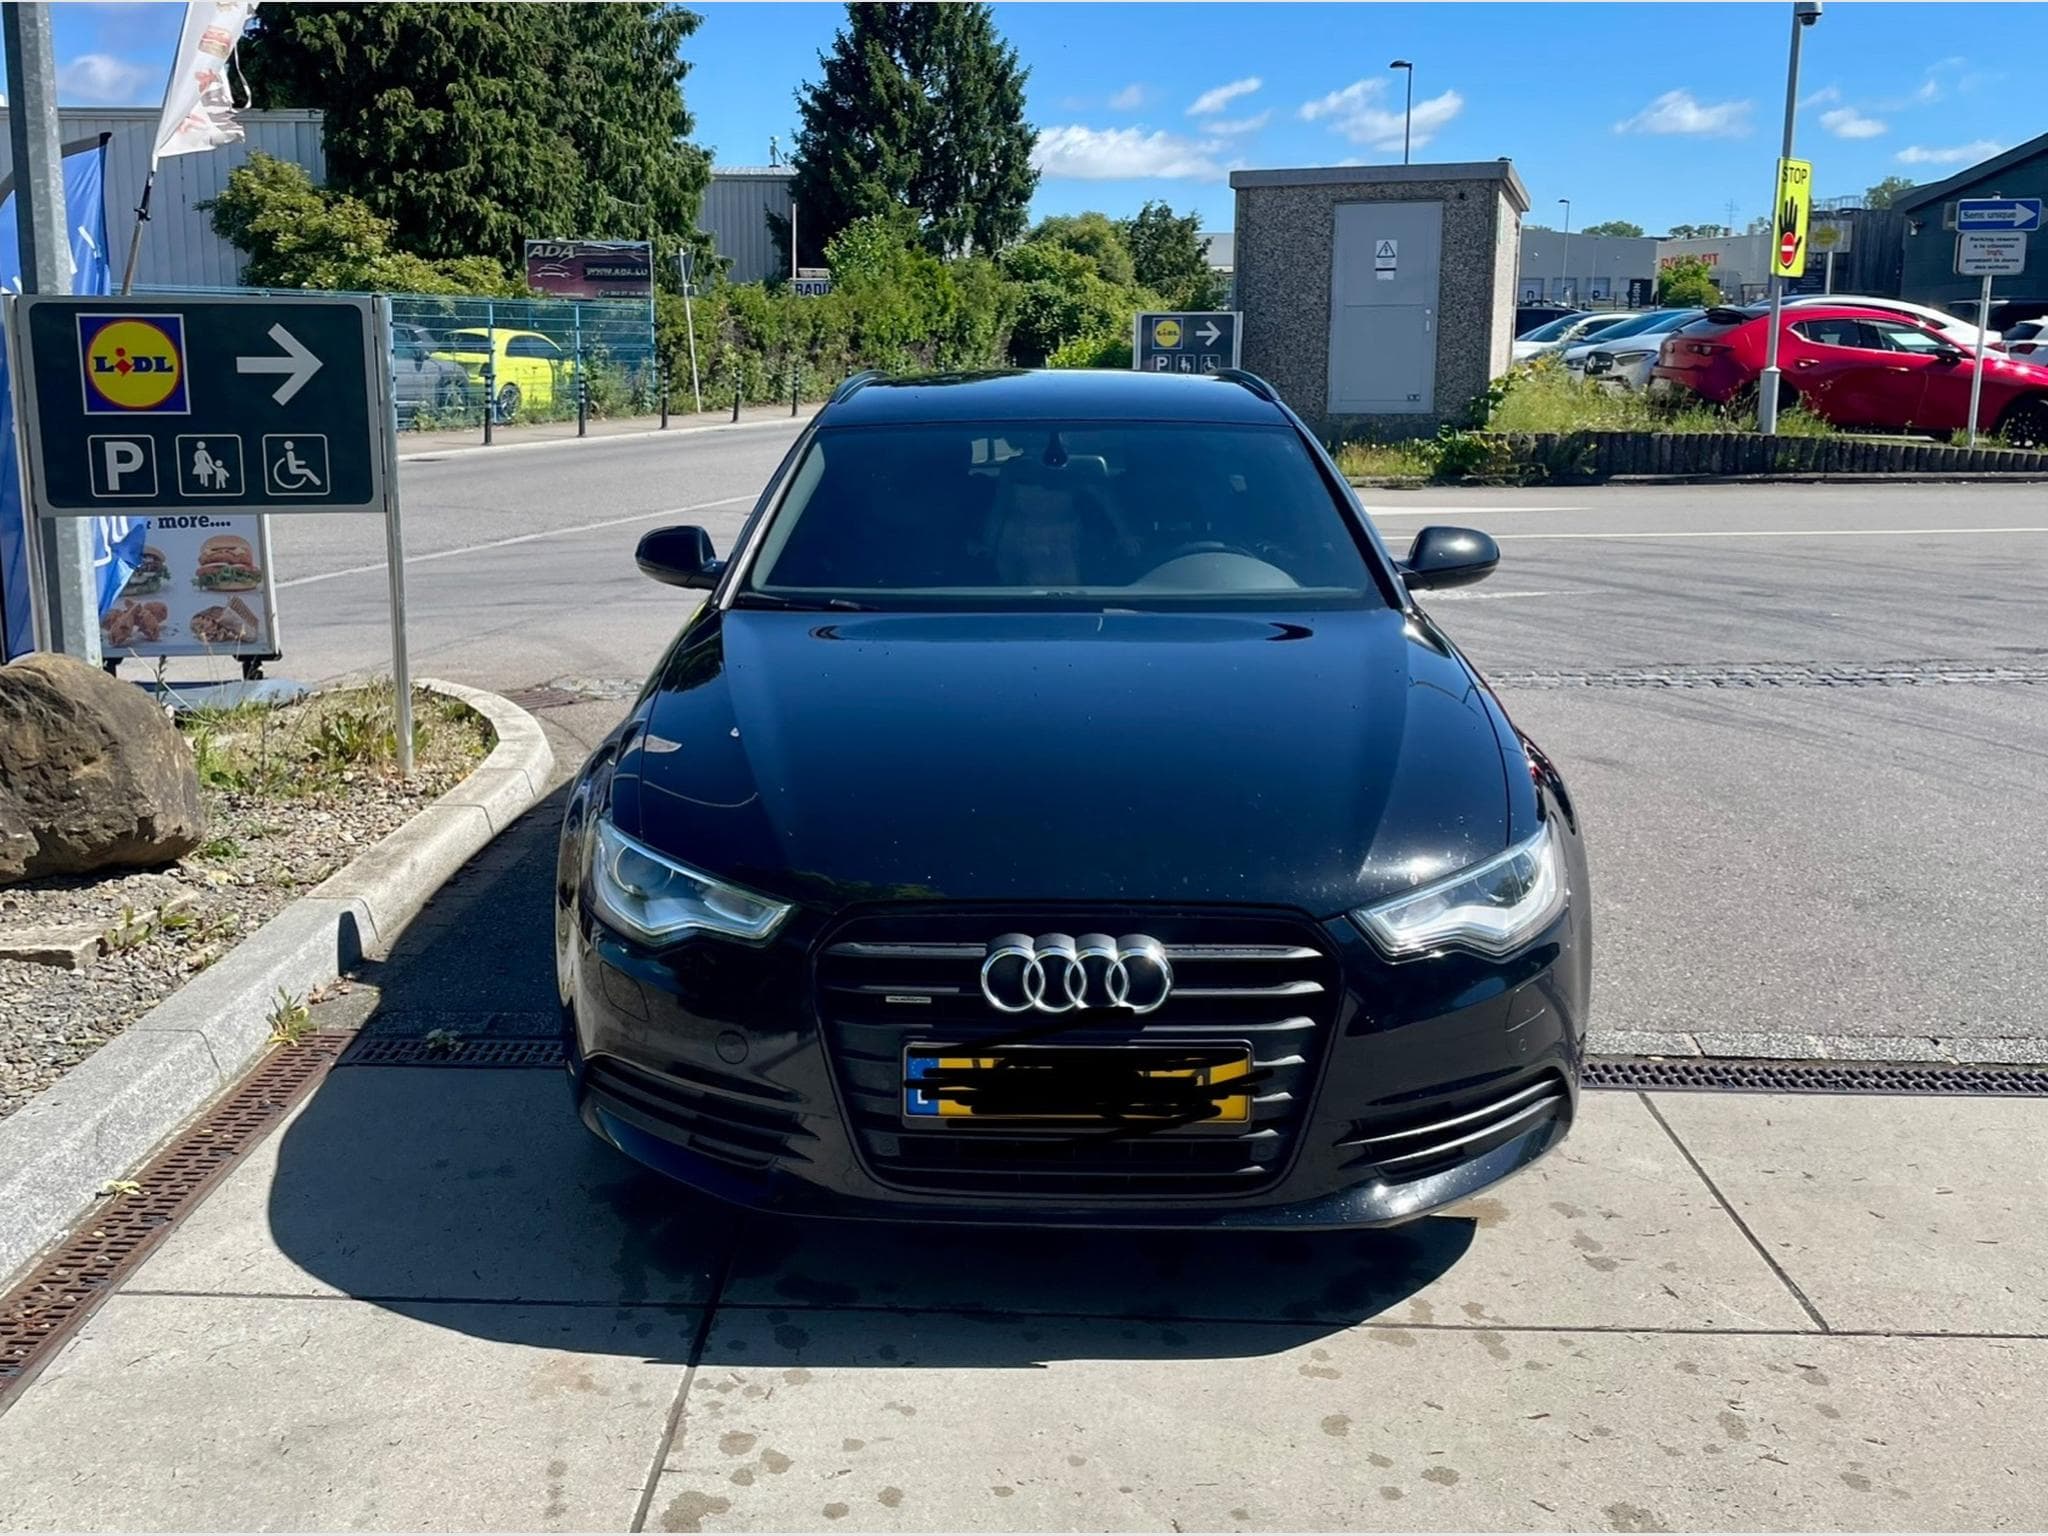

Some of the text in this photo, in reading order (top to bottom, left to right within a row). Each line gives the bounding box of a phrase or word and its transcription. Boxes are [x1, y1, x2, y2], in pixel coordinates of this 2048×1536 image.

[1782, 165, 1808, 184] STOP
[528, 245, 577, 259] ADA
[1156, 356, 1168, 371] P
[104, 441, 144, 491] P
